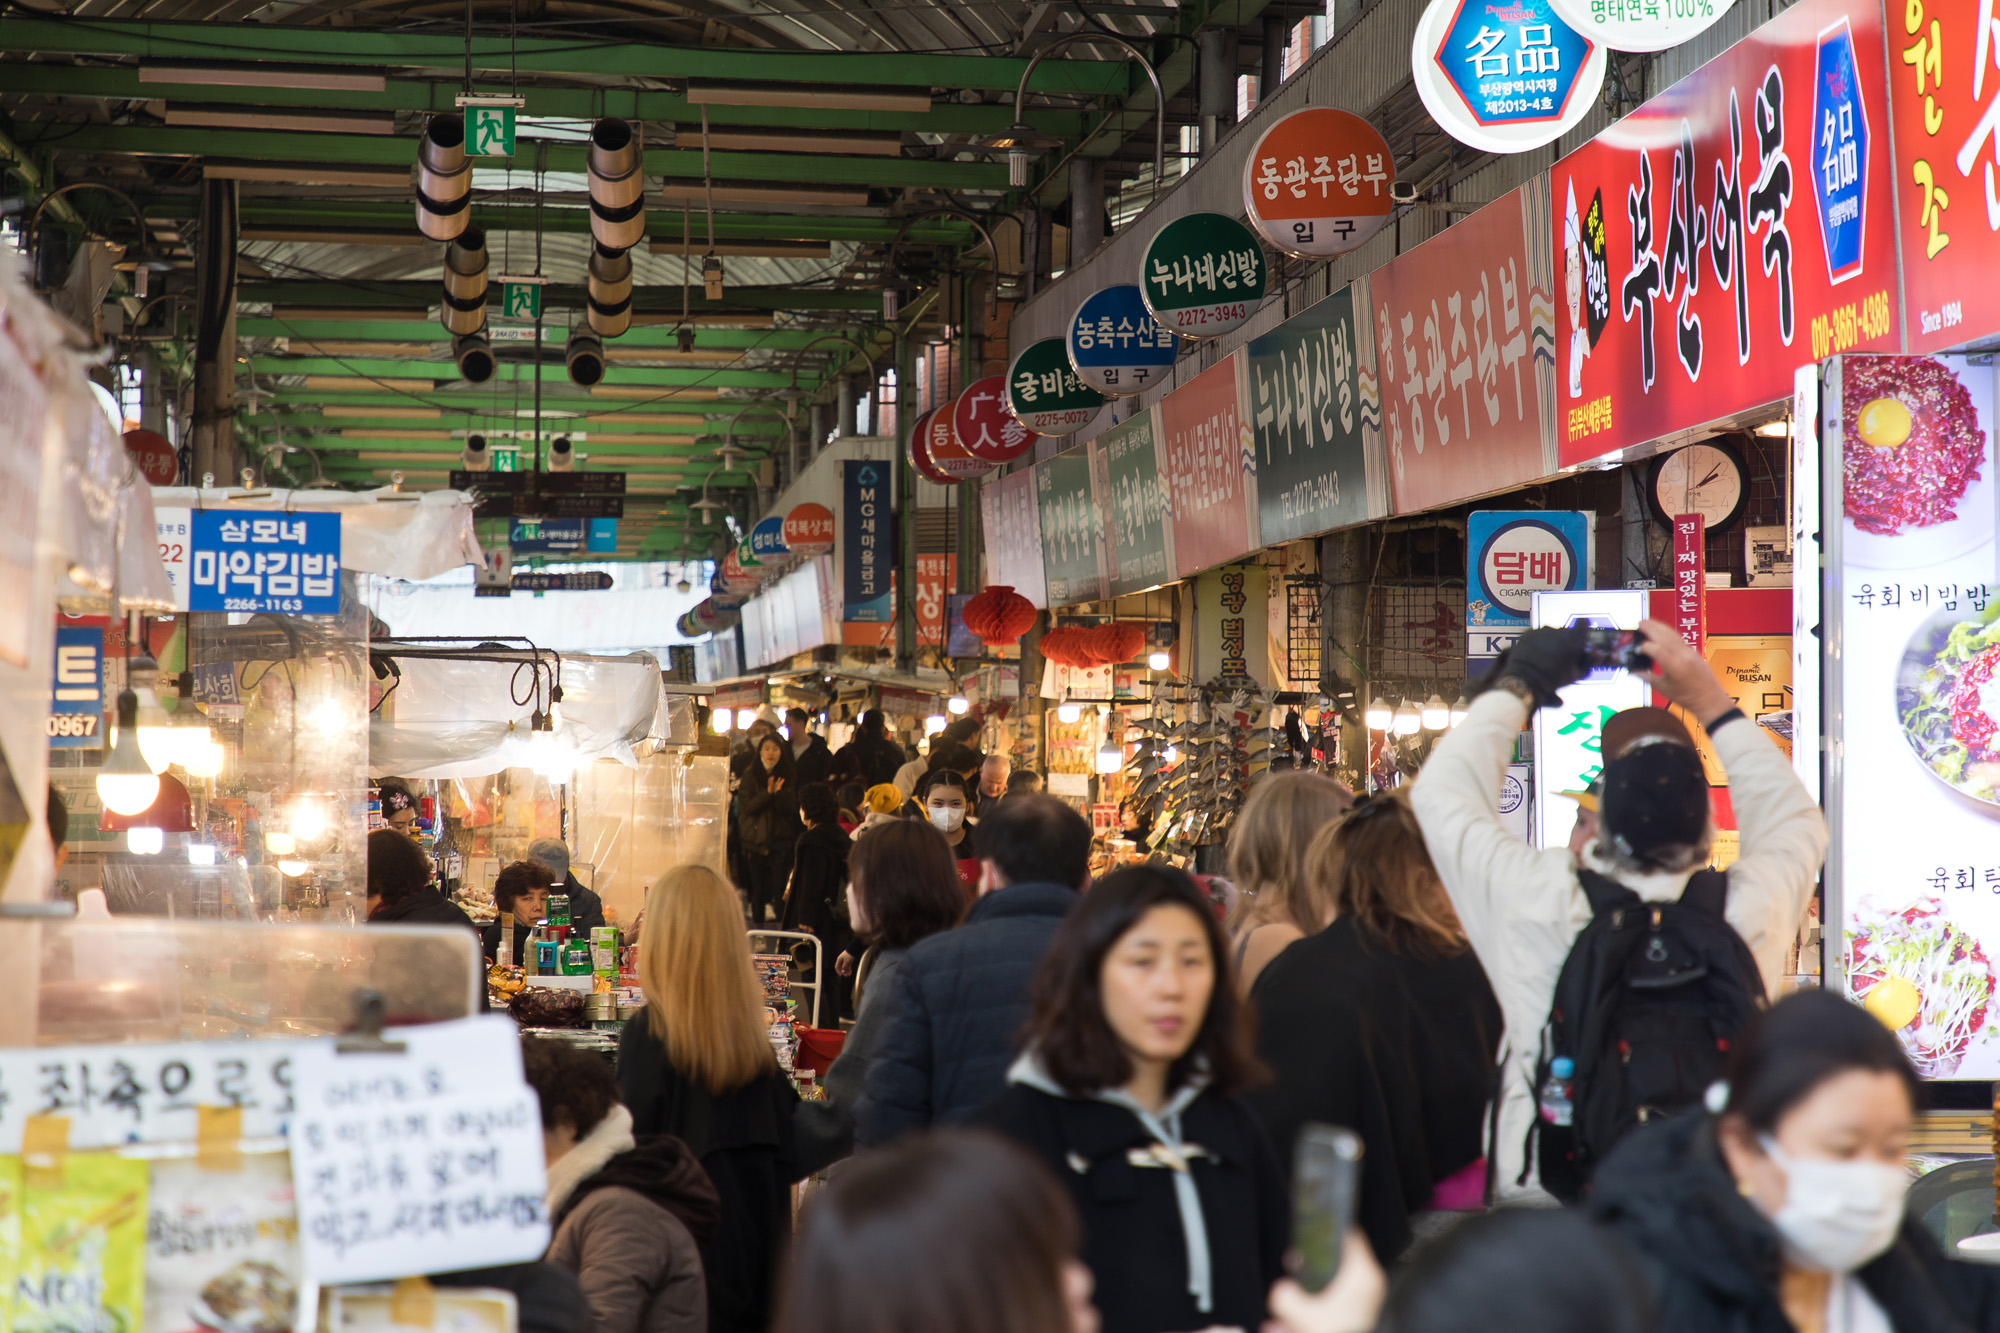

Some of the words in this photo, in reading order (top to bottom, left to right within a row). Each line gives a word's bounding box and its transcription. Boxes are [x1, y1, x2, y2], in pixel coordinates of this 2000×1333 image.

[1500, 10, 1535, 21] BUSAN
[1465, 24, 1561, 79] 名品
[1479, 78, 1558, 96] 부산광역시지정
[1484, 97, 1554, 116] 제2013-4호
[1821, 100, 1859, 198] 名品
[1622, 64, 1794, 394] 부산어묵
[1151, 249, 1259, 297] 누나네신발
[1177, 303, 1246, 327] 2272-3943
[1811, 290, 1890, 360] 010-3661-4386
[1921, 310, 1942, 335] Since
[1941, 300, 1963, 328] 1994
[1014, 368, 1064, 402] 굴비
[1256, 316, 1353, 466] 누나네신발
[1035, 410, 1089, 427] 2275-0072
[219, 519, 307, 545] 삼모녀
[194, 550, 339, 598] 마약김밥
[1493, 552, 1563, 585] 담배
[223, 599, 303, 612] 2266-1163
[1221, 572, 1247, 615] 영광
[1678, 569, 1699, 613] 맛있는
[1851, 583, 1990, 612] 육회비빔밥
[1726, 662, 1761, 678] Dynamic
[1739, 673, 1772, 684] BUSAN
